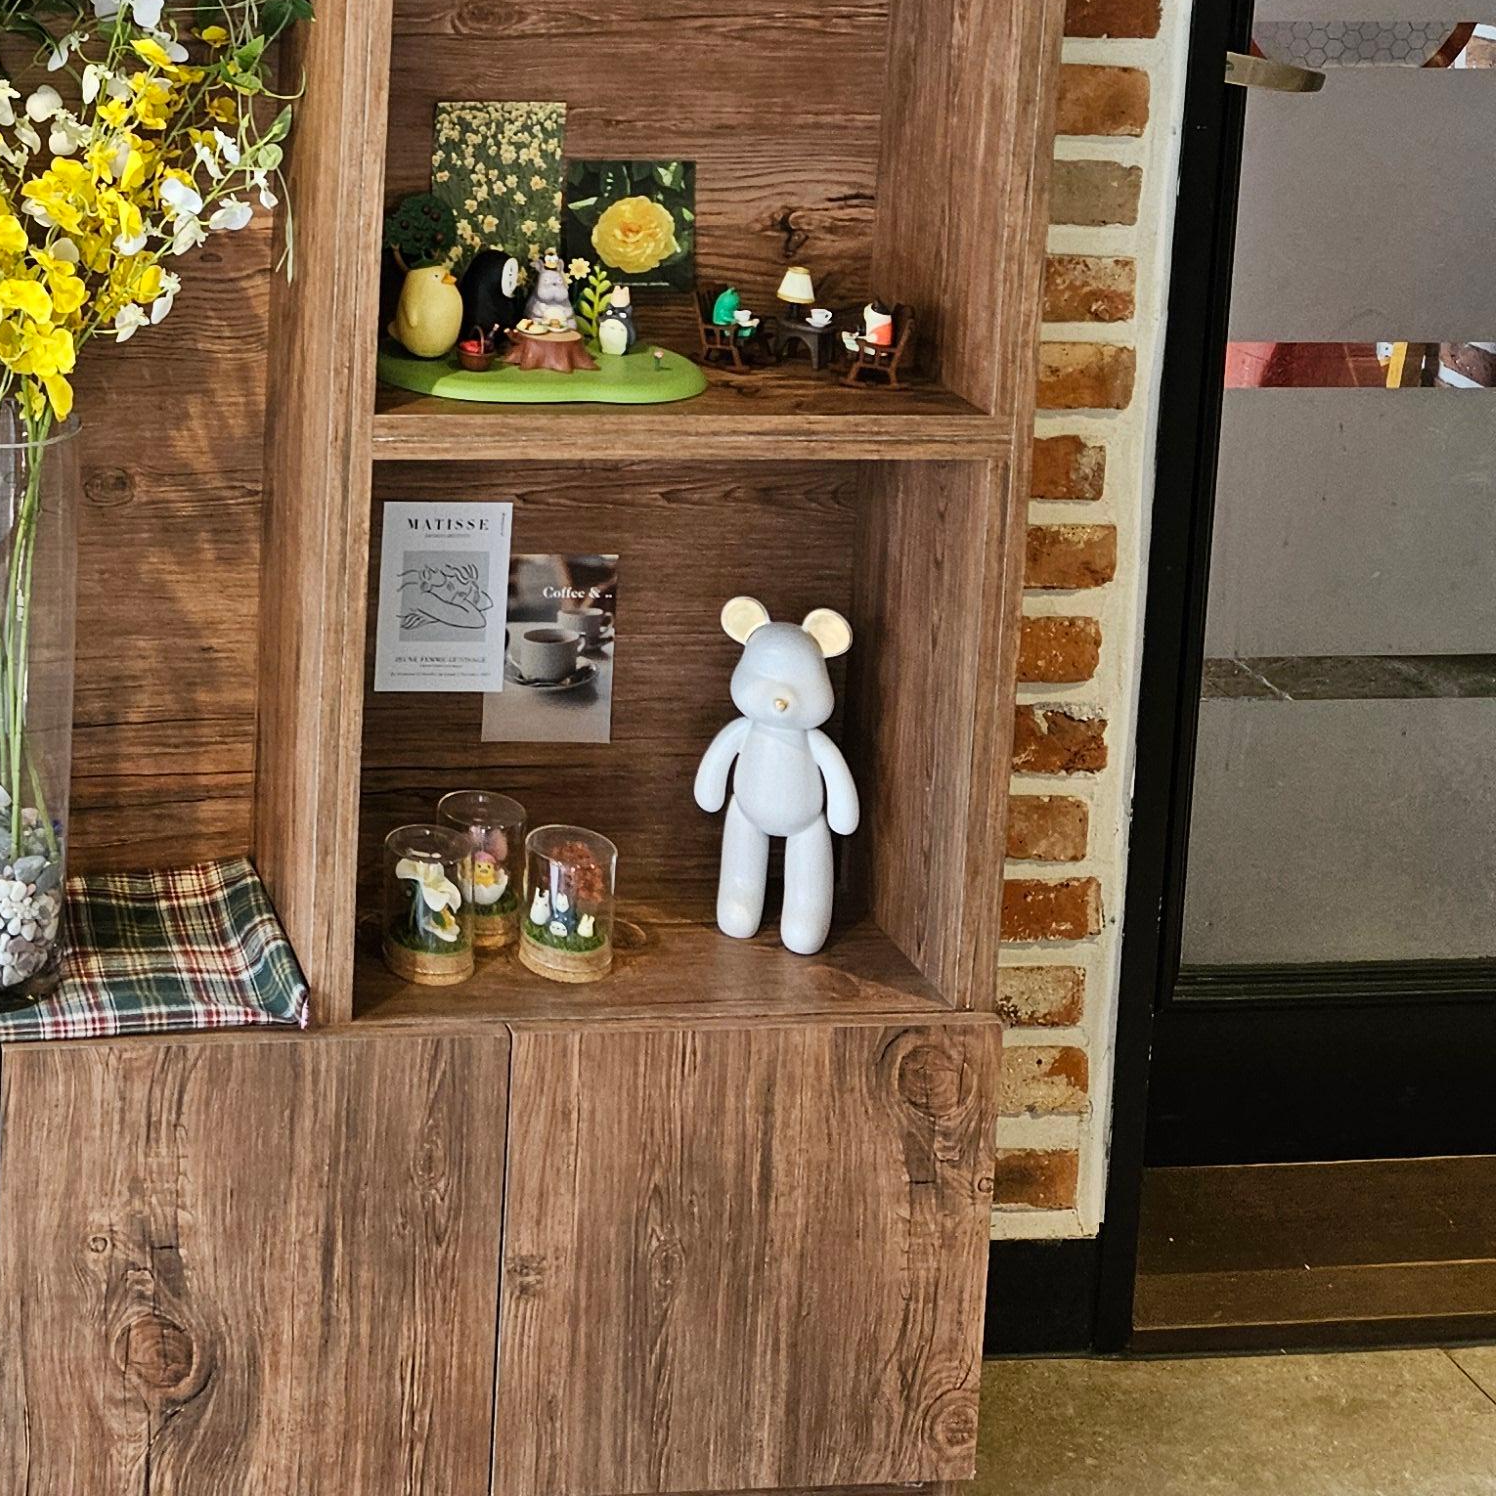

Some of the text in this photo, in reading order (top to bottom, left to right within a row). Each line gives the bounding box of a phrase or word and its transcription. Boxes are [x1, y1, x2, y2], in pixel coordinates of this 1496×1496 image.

[407, 518, 490, 531] MATISSE
[542, 585, 586, 600] Coffee
[588, 586, 601, 599] &
